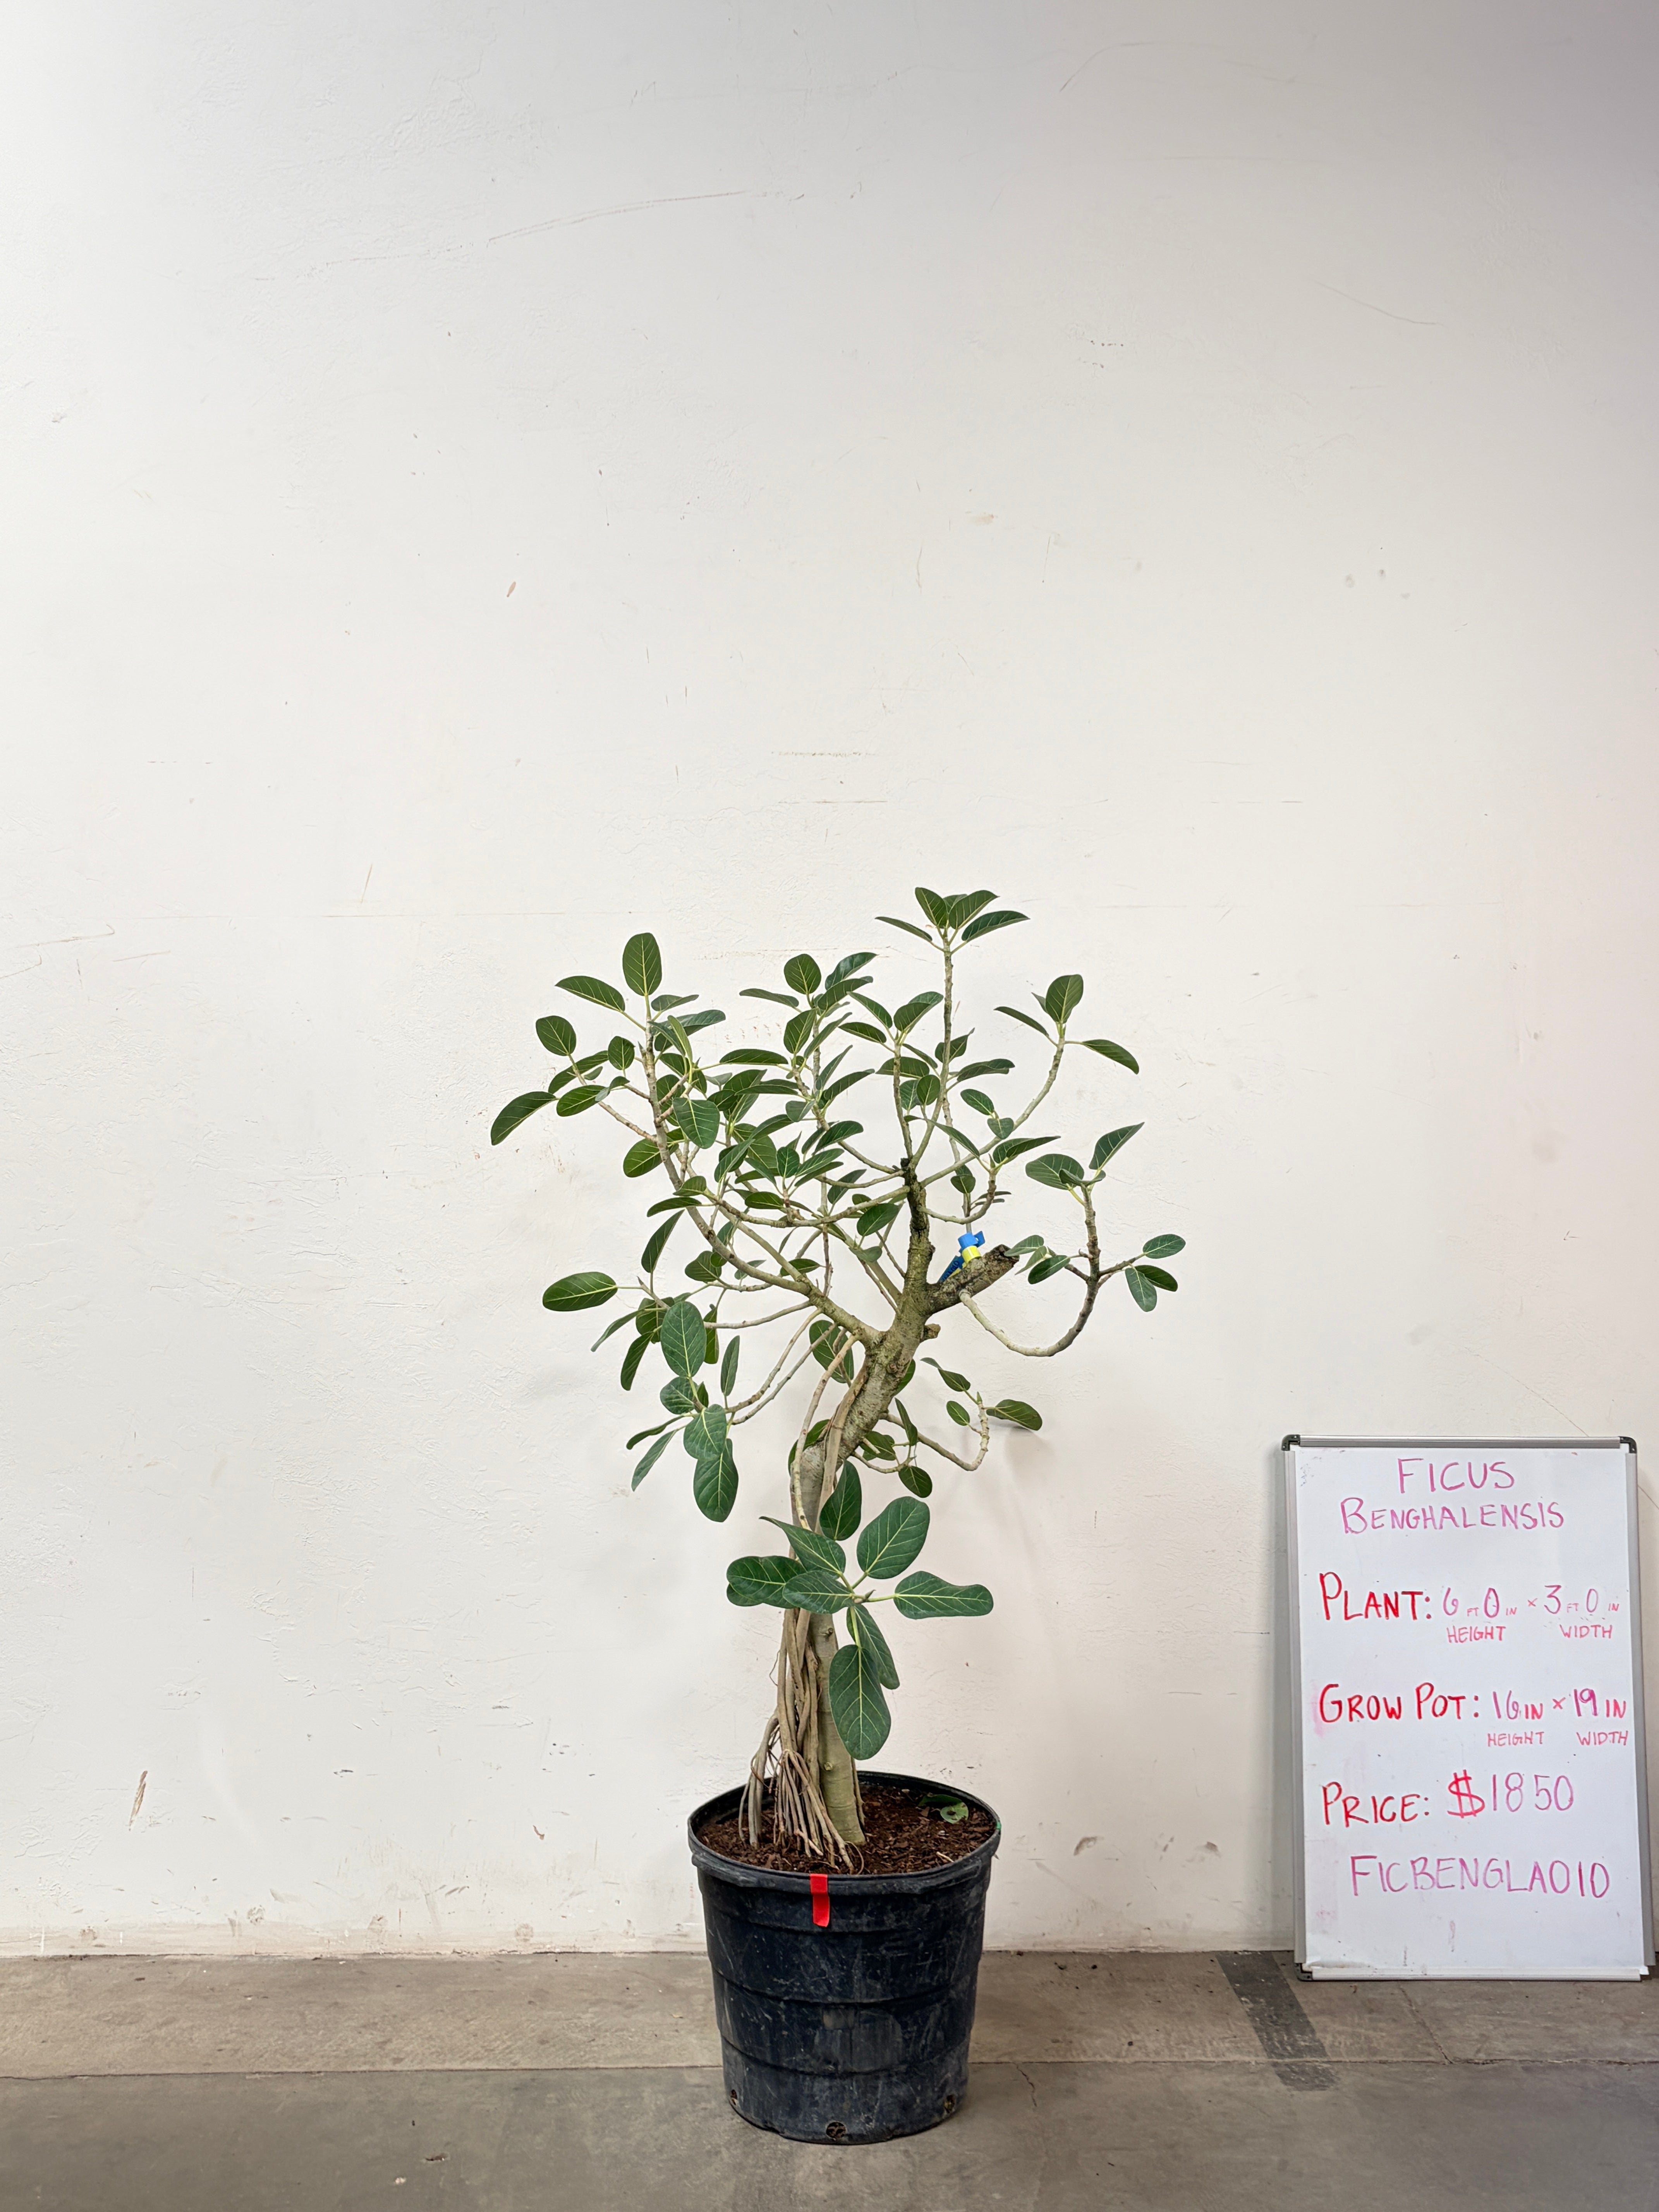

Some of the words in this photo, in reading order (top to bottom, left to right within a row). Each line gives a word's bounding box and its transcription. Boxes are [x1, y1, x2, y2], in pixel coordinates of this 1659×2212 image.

[1397, 1458, 1515, 1494] FICUS
[1340, 1497, 1565, 1535] BENGHALENSIS
[1319, 1571, 1432, 1621] PLANT:
[1447, 1626, 1506, 1644] HEIGHT
[1559, 1624, 1613, 1639] WIDTH
[1319, 1683, 1402, 1723] GROW
[1414, 1682, 1479, 1721] POT:
[1487, 1731, 1544, 1747] HEIGHT
[1576, 1730, 1629, 1746] WIDTH
[1322, 1781, 1429, 1828] PRICE:
[1447, 1769, 1574, 1819] $1850
